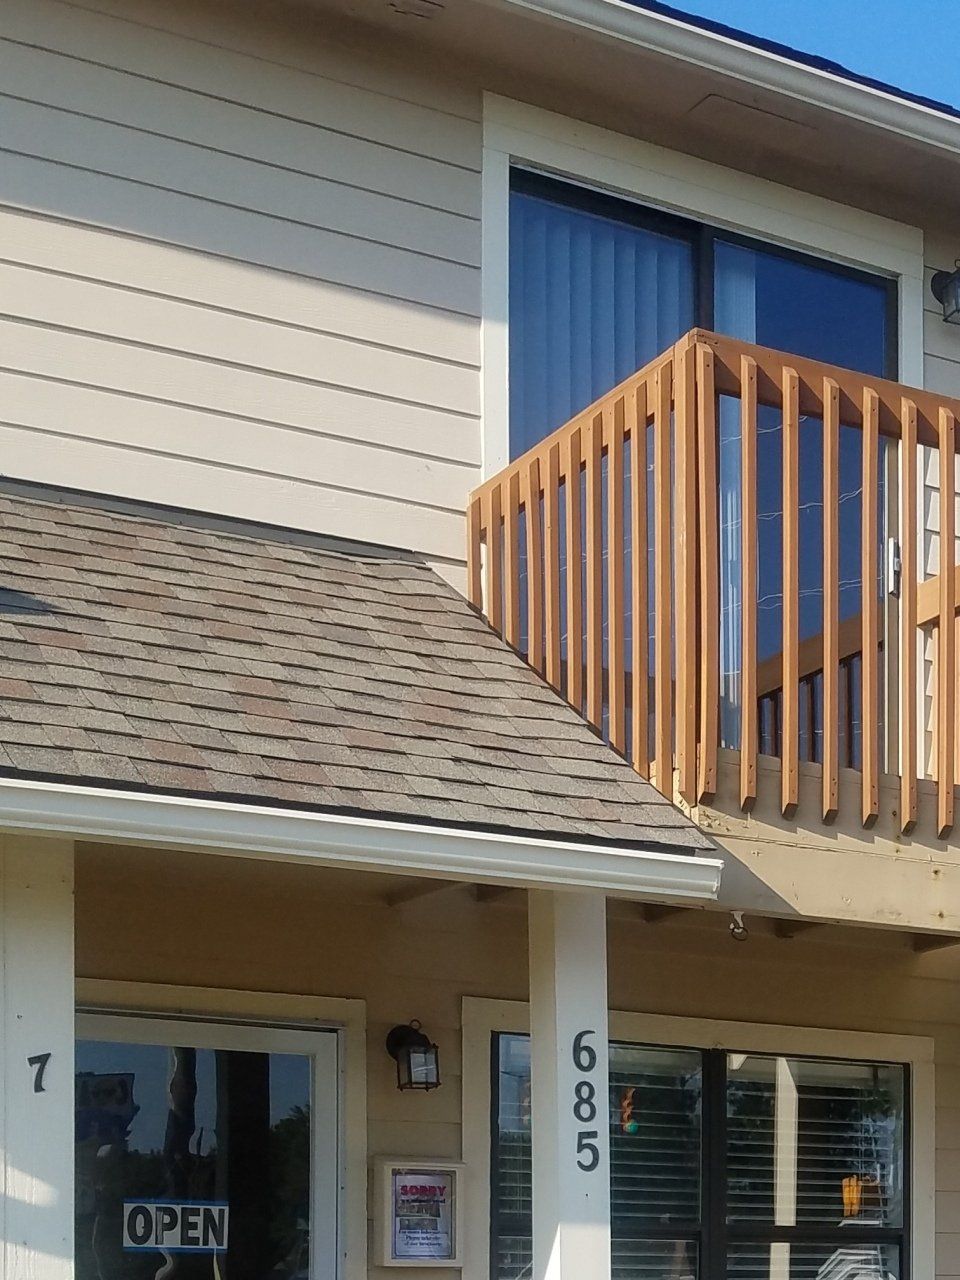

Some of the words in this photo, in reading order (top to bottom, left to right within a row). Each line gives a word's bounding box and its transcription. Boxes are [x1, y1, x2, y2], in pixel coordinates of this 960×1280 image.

[27, 1052, 51, 1093] 7
[572, 1029, 600, 1173] 685
[126, 1204, 226, 1247] OPEN
